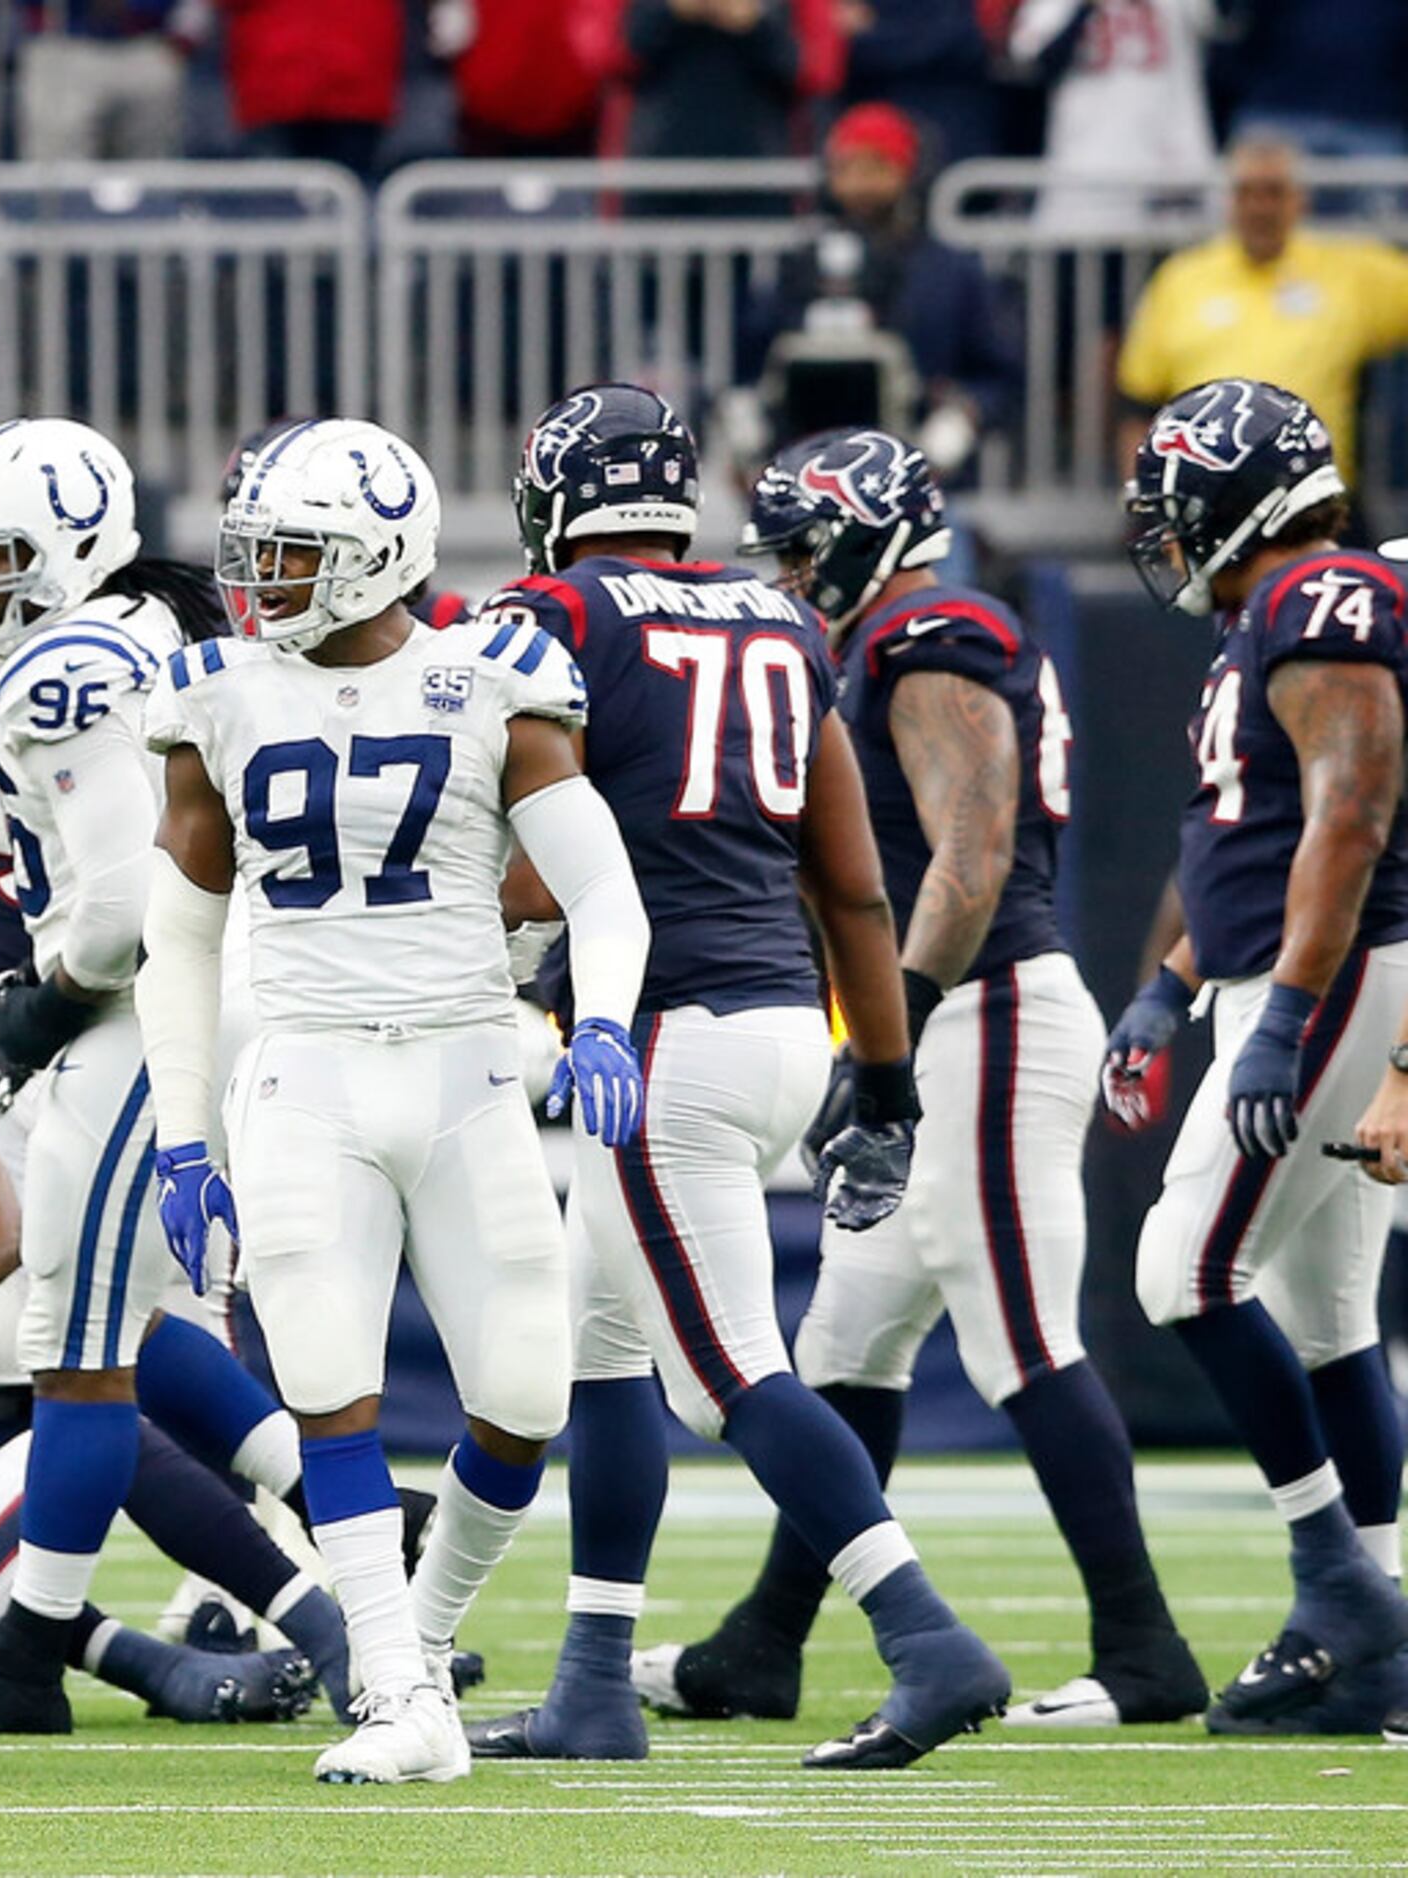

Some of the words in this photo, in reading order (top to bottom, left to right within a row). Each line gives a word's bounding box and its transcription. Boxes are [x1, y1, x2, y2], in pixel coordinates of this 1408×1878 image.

[598, 573, 803, 626] DAVENPORT
[1300, 579, 1375, 643] 74
[30, 678, 110, 731] 96
[422, 667, 473, 698] 35
[642, 624, 810, 820] 70
[242, 733, 452, 909] 97
